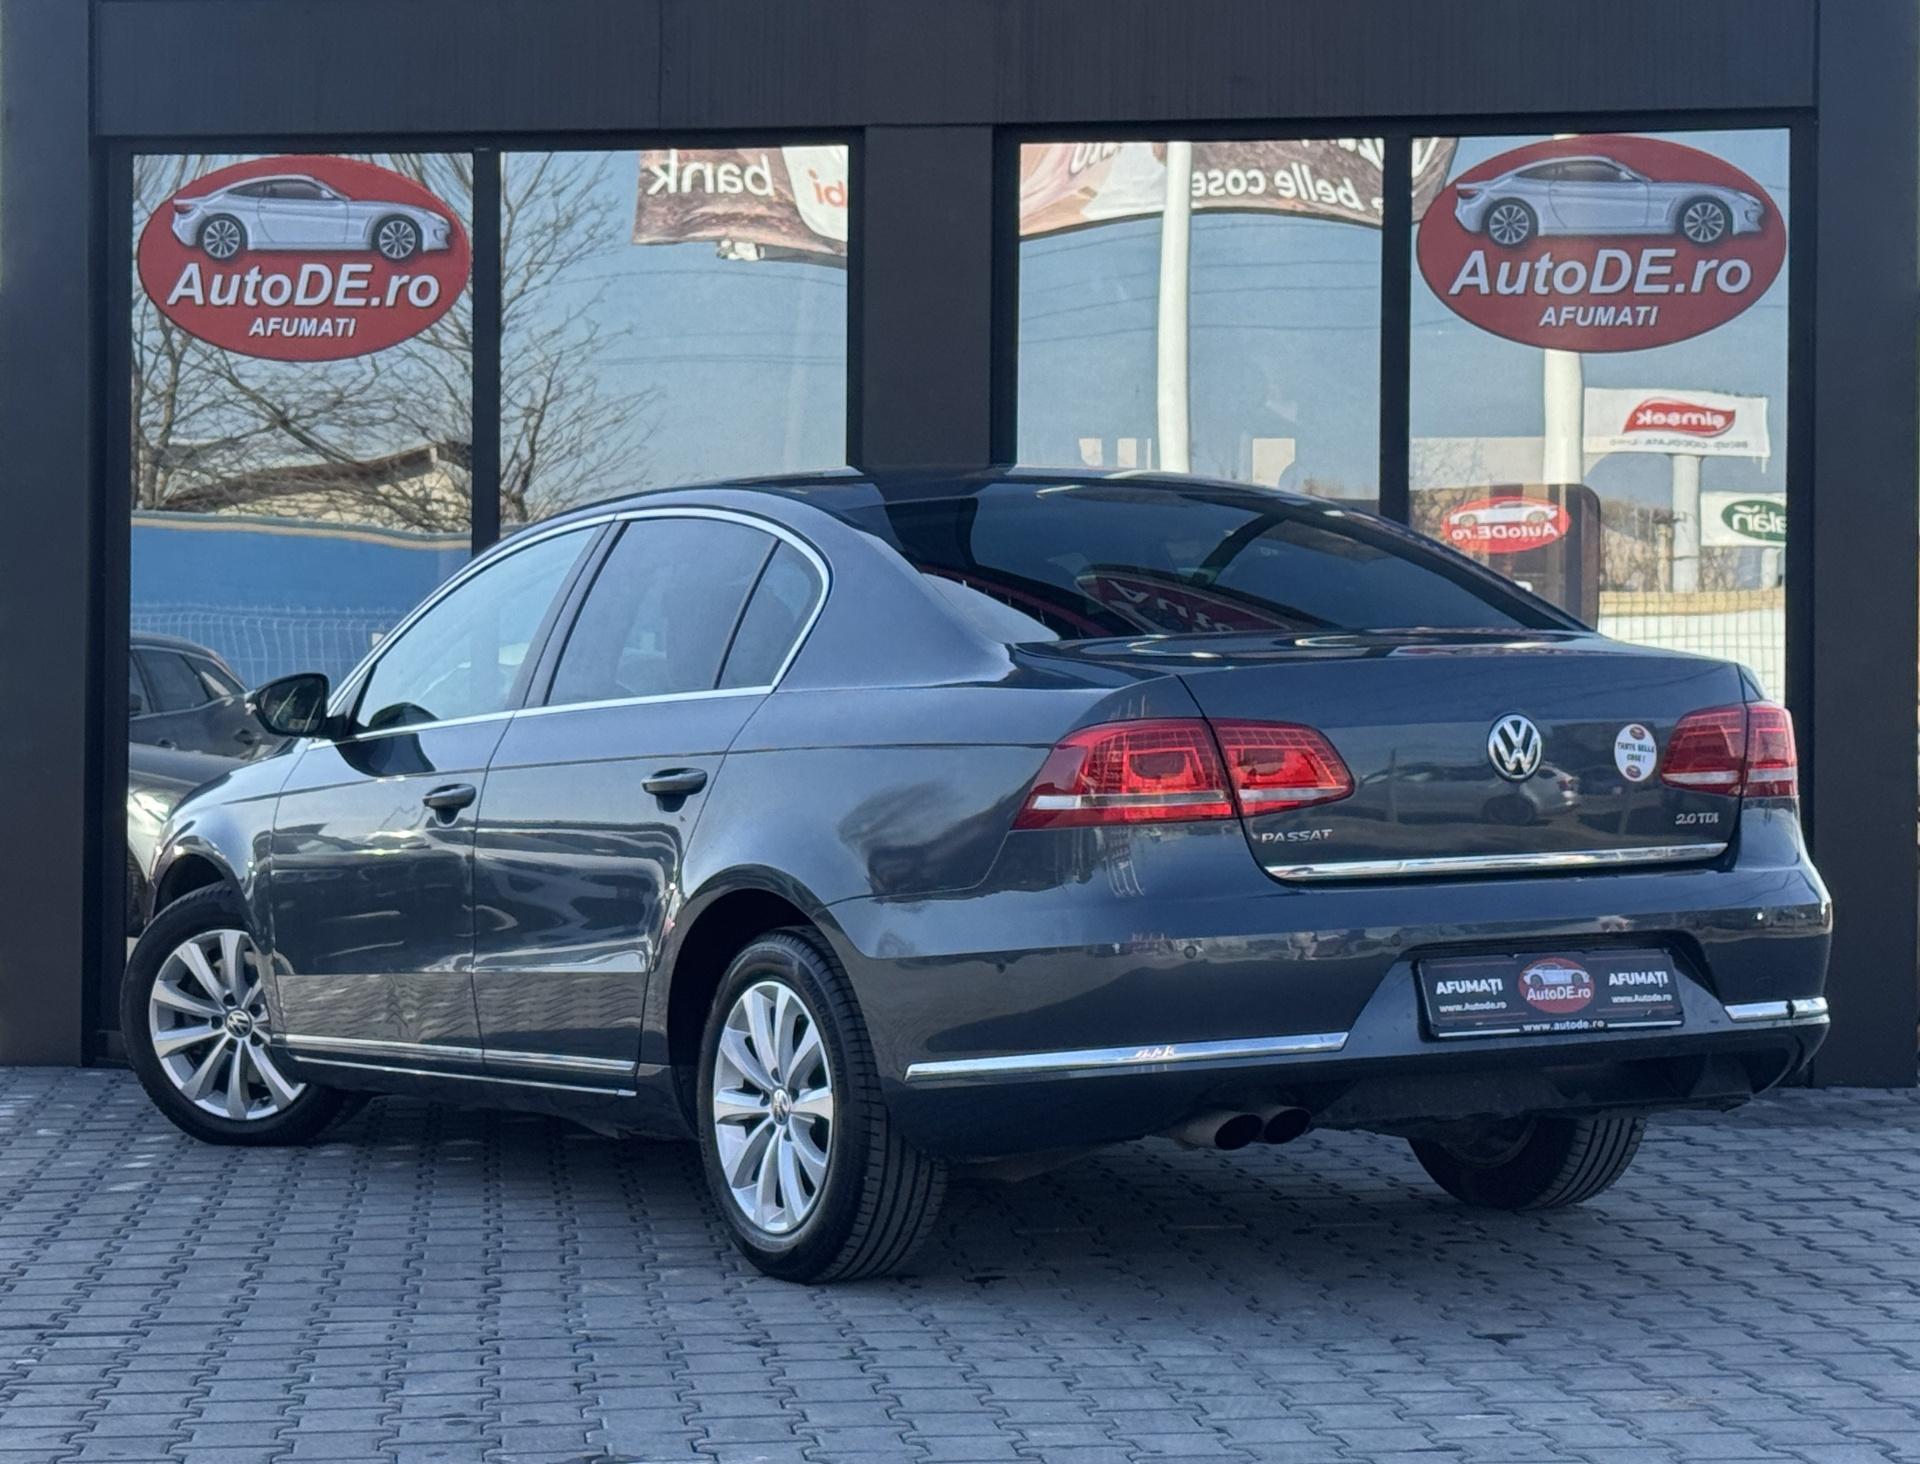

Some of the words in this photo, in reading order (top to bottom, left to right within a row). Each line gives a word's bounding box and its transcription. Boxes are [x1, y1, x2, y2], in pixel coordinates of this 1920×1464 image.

[1449, 248, 1751, 296] AutoDE.ro
[167, 262, 441, 308] AutoDE.ro
[1539, 306, 1659, 327] AFUMATI
[248, 317, 357, 338] AFUMATI
[1261, 829, 1333, 843] PASSAT
[1526, 985, 1591, 1001] AutoDE.ro
[1523, 1019, 1605, 1033] www.autode.ro
